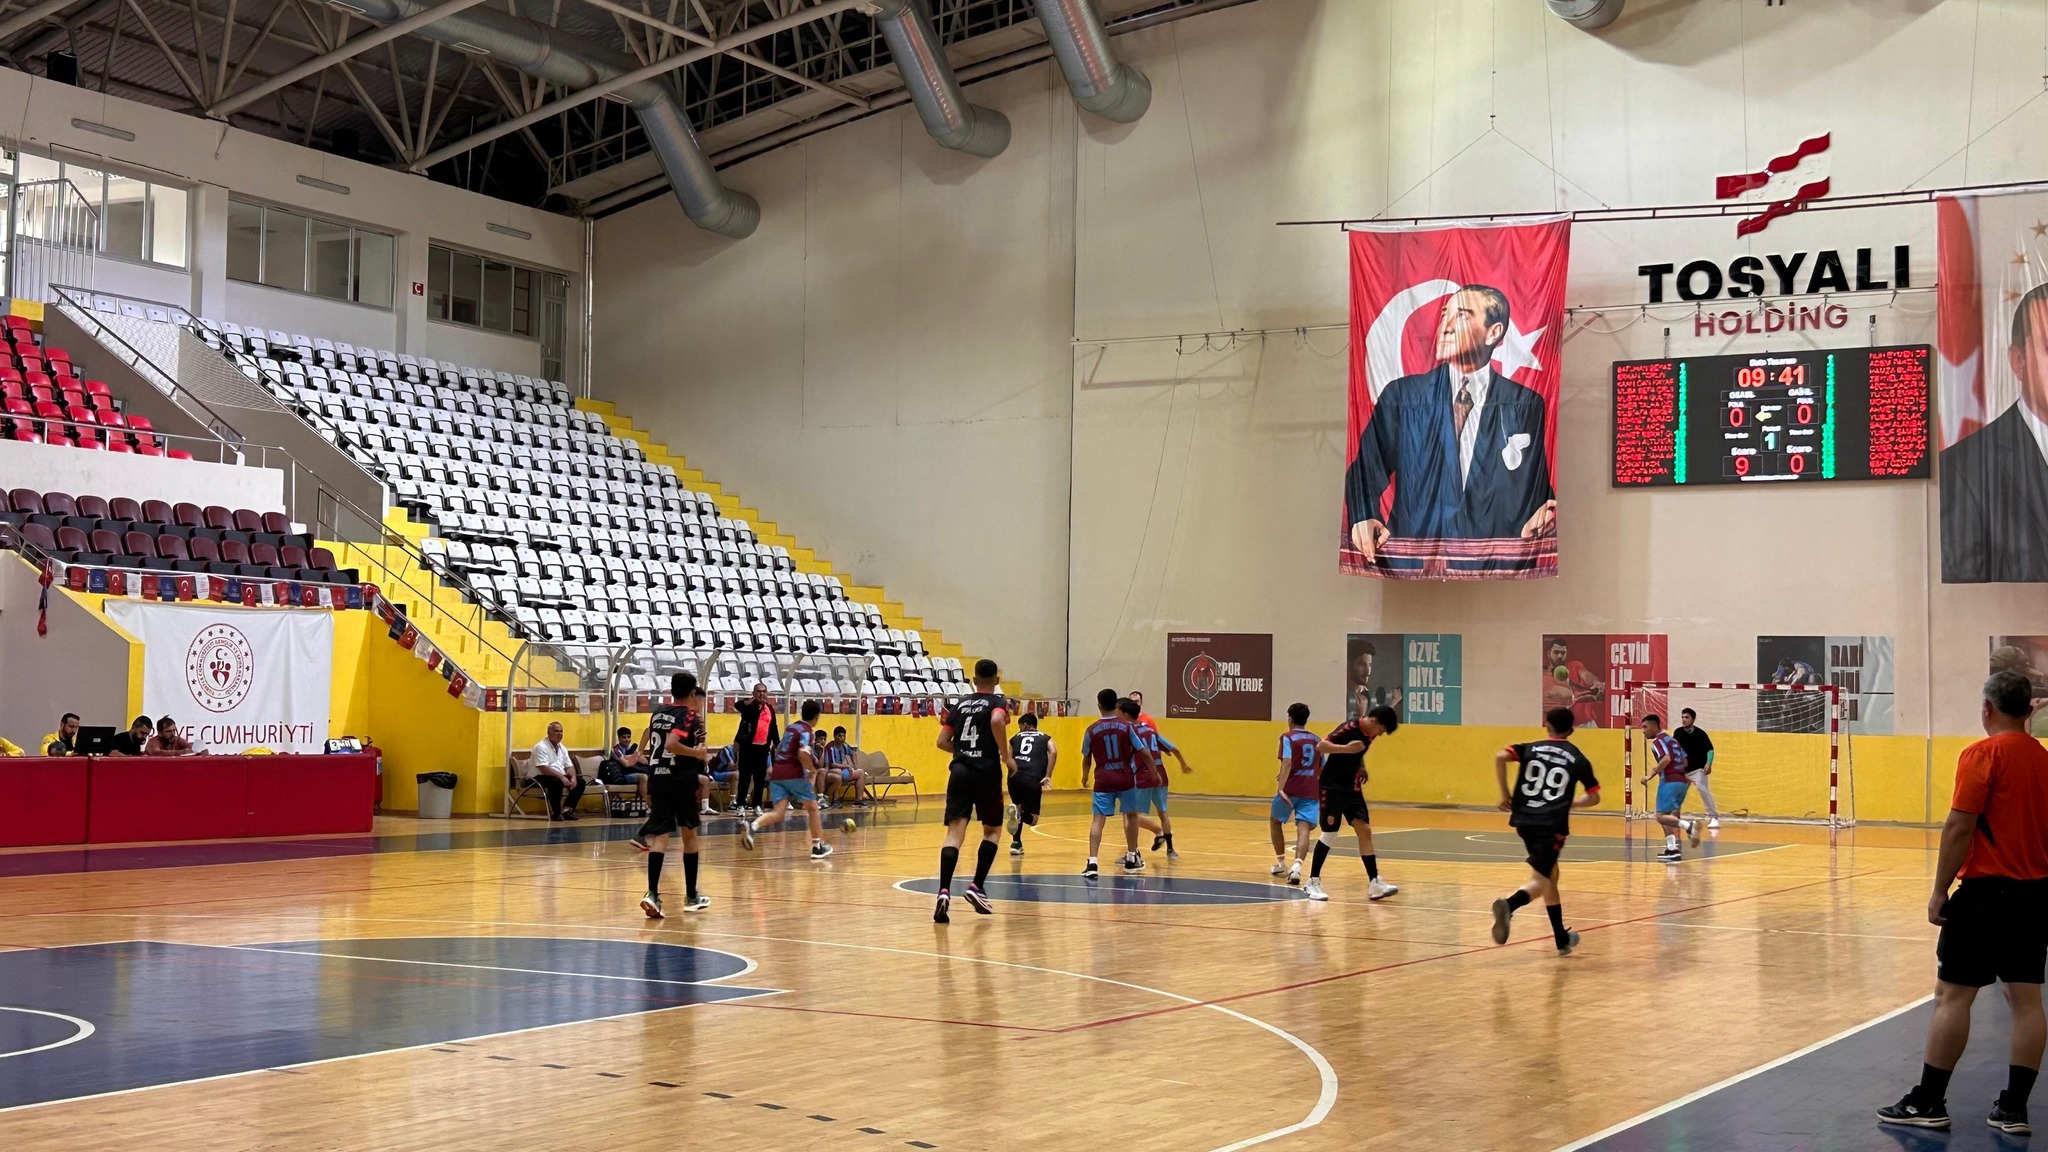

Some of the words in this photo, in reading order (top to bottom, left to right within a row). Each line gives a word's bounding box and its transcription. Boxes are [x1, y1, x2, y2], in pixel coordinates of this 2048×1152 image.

[1638, 245, 1910, 303] TOSYALI
[1694, 302, 1848, 337] HOLDİNG
[1729, 407, 1745, 427] 0
[1797, 404, 1813, 425] 0
[1764, 432, 1776, 450] 1
[1735, 455, 1750, 476] 9
[1790, 453, 1804, 474] 0
[1234, 677, 1264, 692] YERDE
[1408, 690, 1445, 715] GELİŞ
[960, 716, 979, 749] 4
[1020, 736, 1035, 755] 6
[1103, 733, 1120, 760] 11
[1301, 743, 1315, 767] 9
[1521, 759, 1570, 801] 99
